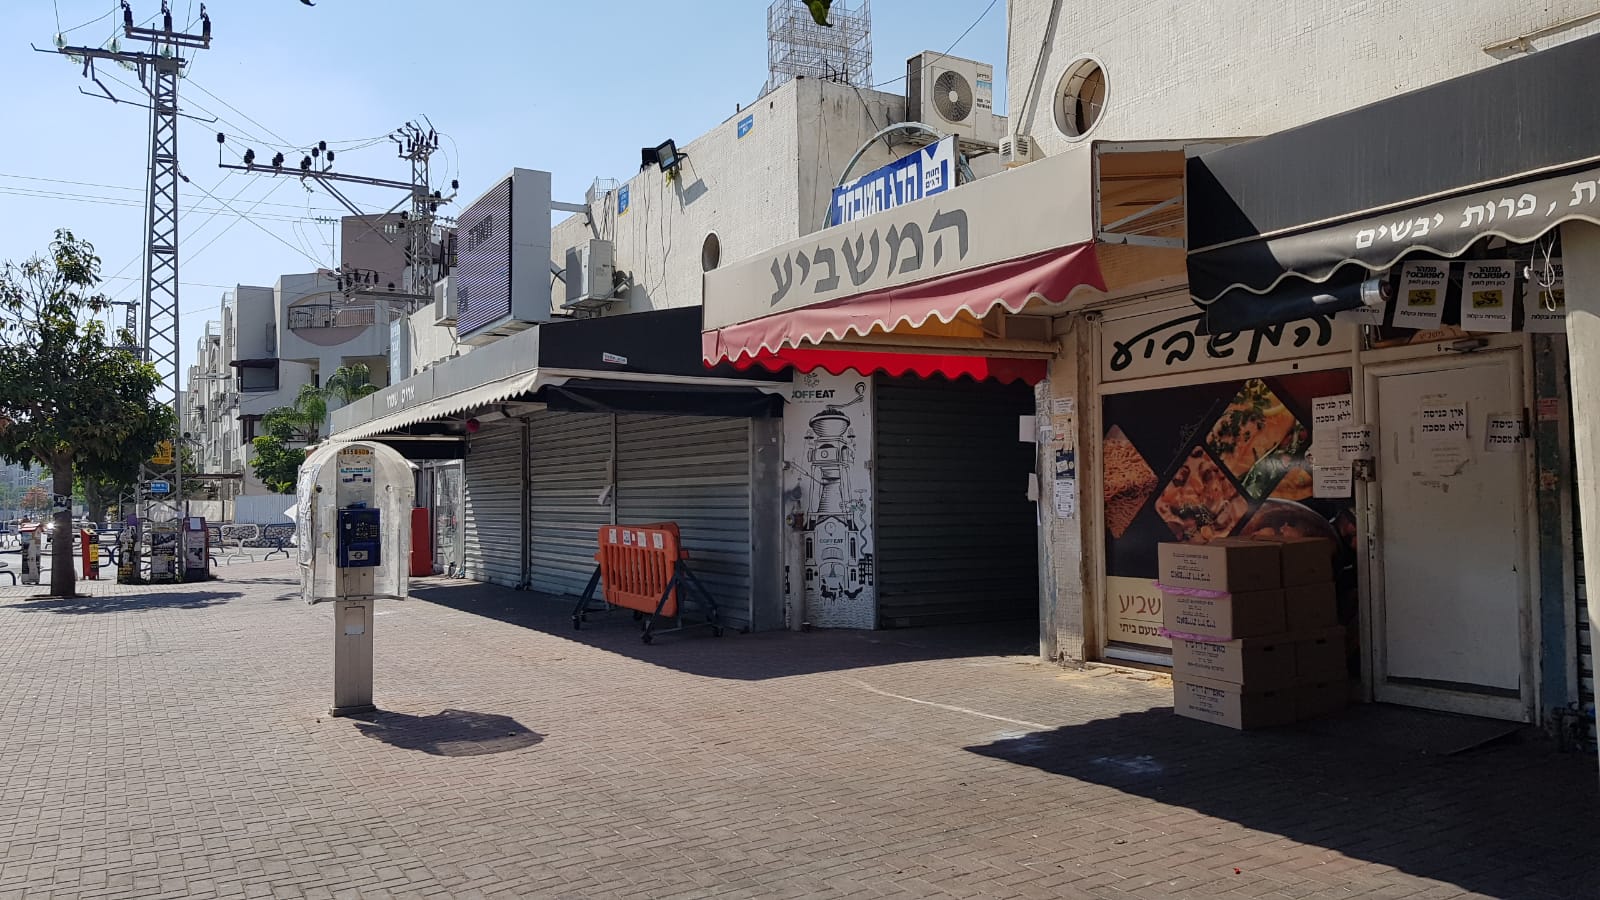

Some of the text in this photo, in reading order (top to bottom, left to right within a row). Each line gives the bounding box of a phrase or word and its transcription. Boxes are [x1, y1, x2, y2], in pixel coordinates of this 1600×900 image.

[925, 167, 940, 179] חנות
[925, 176, 941, 189] דגים
[837, 163, 918, 225] הדג המובחר
[1459, 192, 1538, 229] פרות
[1355, 212, 1445, 249] יבשים
[769, 208, 969, 307] המשביע
[1110, 311, 1333, 371] המשביע
[1315, 398, 1351, 410] אין כניסה
[1315, 410, 1351, 424] ללא מסכה
[1423, 407, 1464, 418] אין כניסה
[1422, 420, 1465, 433] ללא מסכה
[1119, 623, 1137, 634] ביתי
